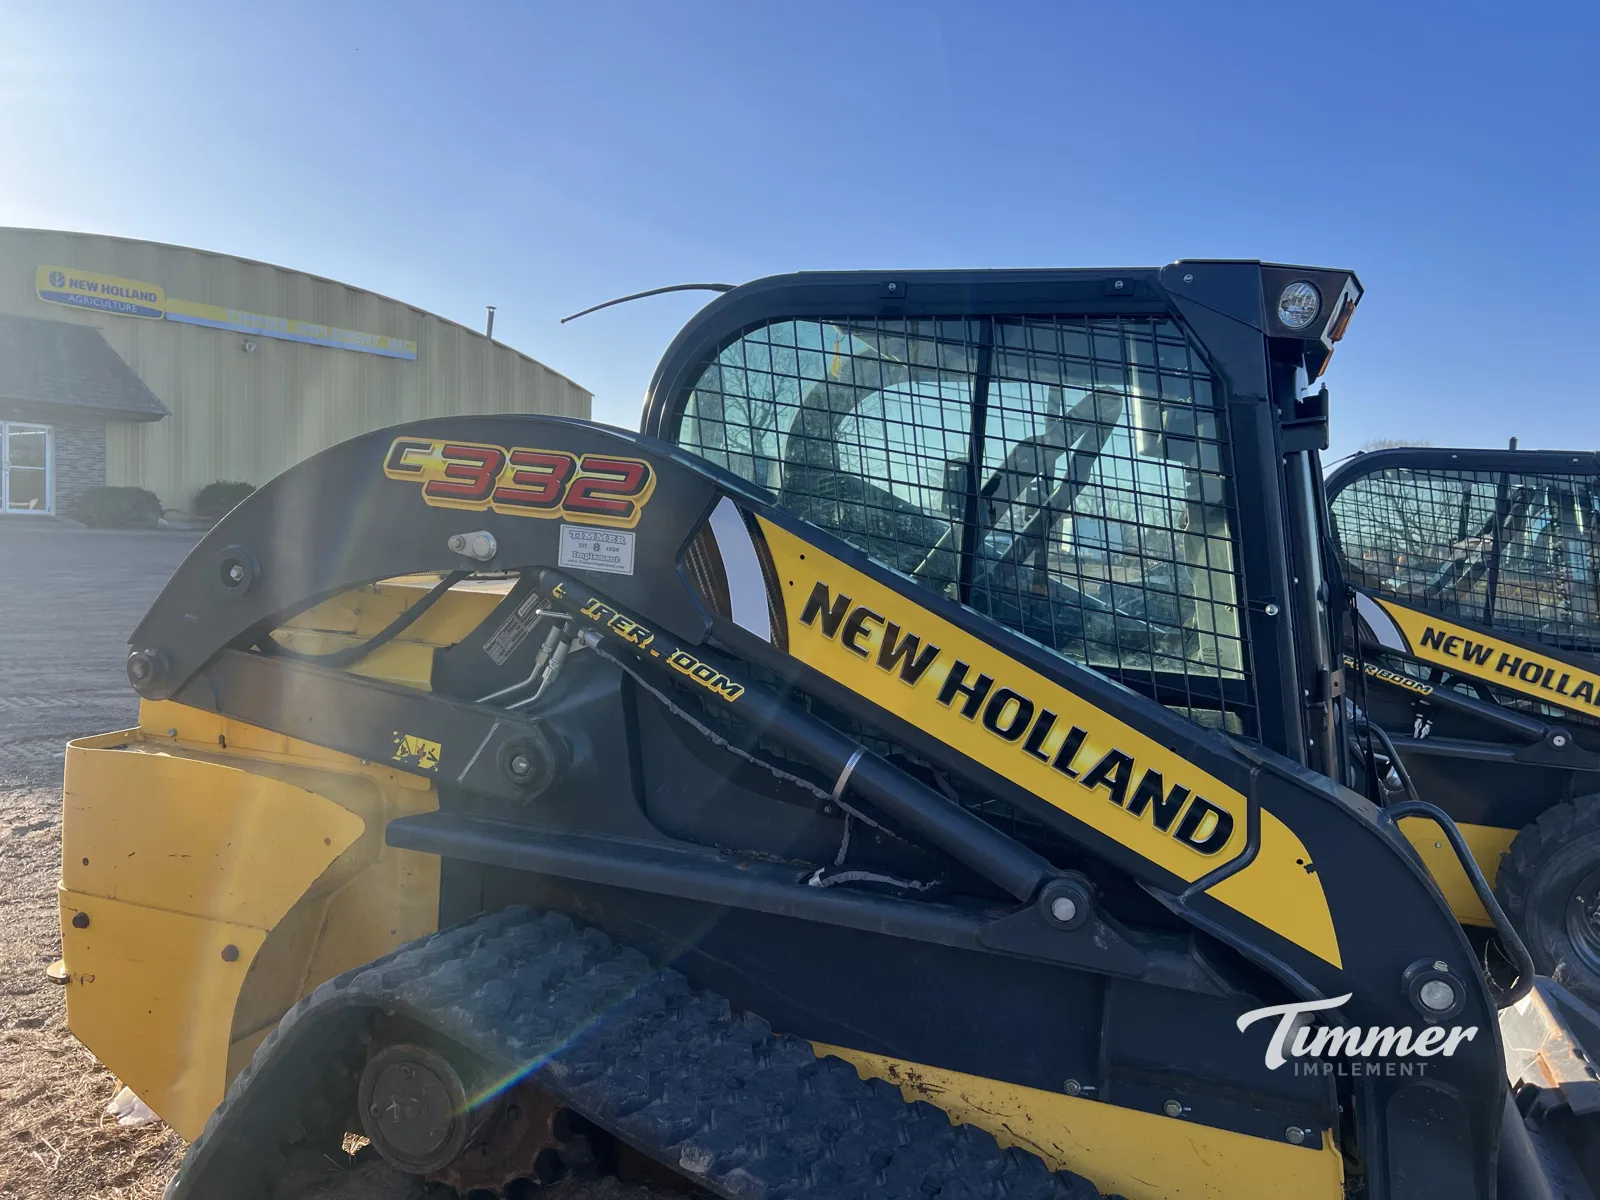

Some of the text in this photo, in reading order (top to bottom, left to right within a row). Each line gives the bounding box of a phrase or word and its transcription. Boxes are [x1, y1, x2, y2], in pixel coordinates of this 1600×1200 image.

[68, 278, 157, 303] NEW HOLLAND
[68, 294, 138, 313] AGRICULTURE
[384, 437, 656, 528] C332
[569, 530, 626, 545] TIMMER
[572, 551, 621, 563] Implement
[1419, 626, 1495, 667] NEW
[666, 647, 745, 703] OOM
[1376, 668, 1434, 696] BOOM
[799, 580, 1235, 856] NEW HOLLAND
